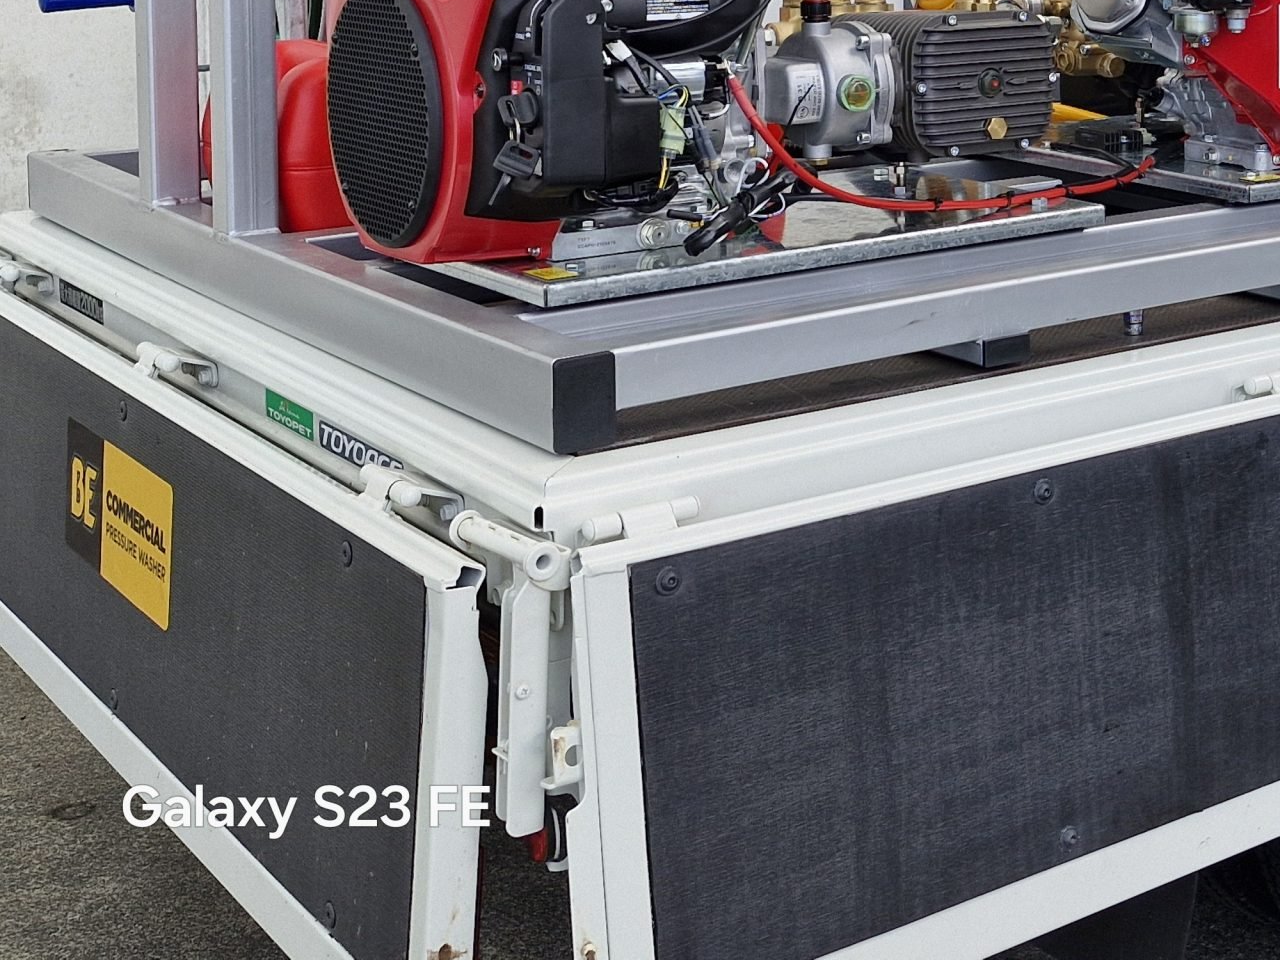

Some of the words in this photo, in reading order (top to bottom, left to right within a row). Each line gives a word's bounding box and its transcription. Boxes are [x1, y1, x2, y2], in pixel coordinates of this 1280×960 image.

[268, 407, 312, 436] TOYOPET
[70, 455, 97, 529] BE
[106, 490, 166, 554] COMMERCIAL
[105, 522, 137, 561] PRESSURE
[138, 544, 166, 583] WASHER
